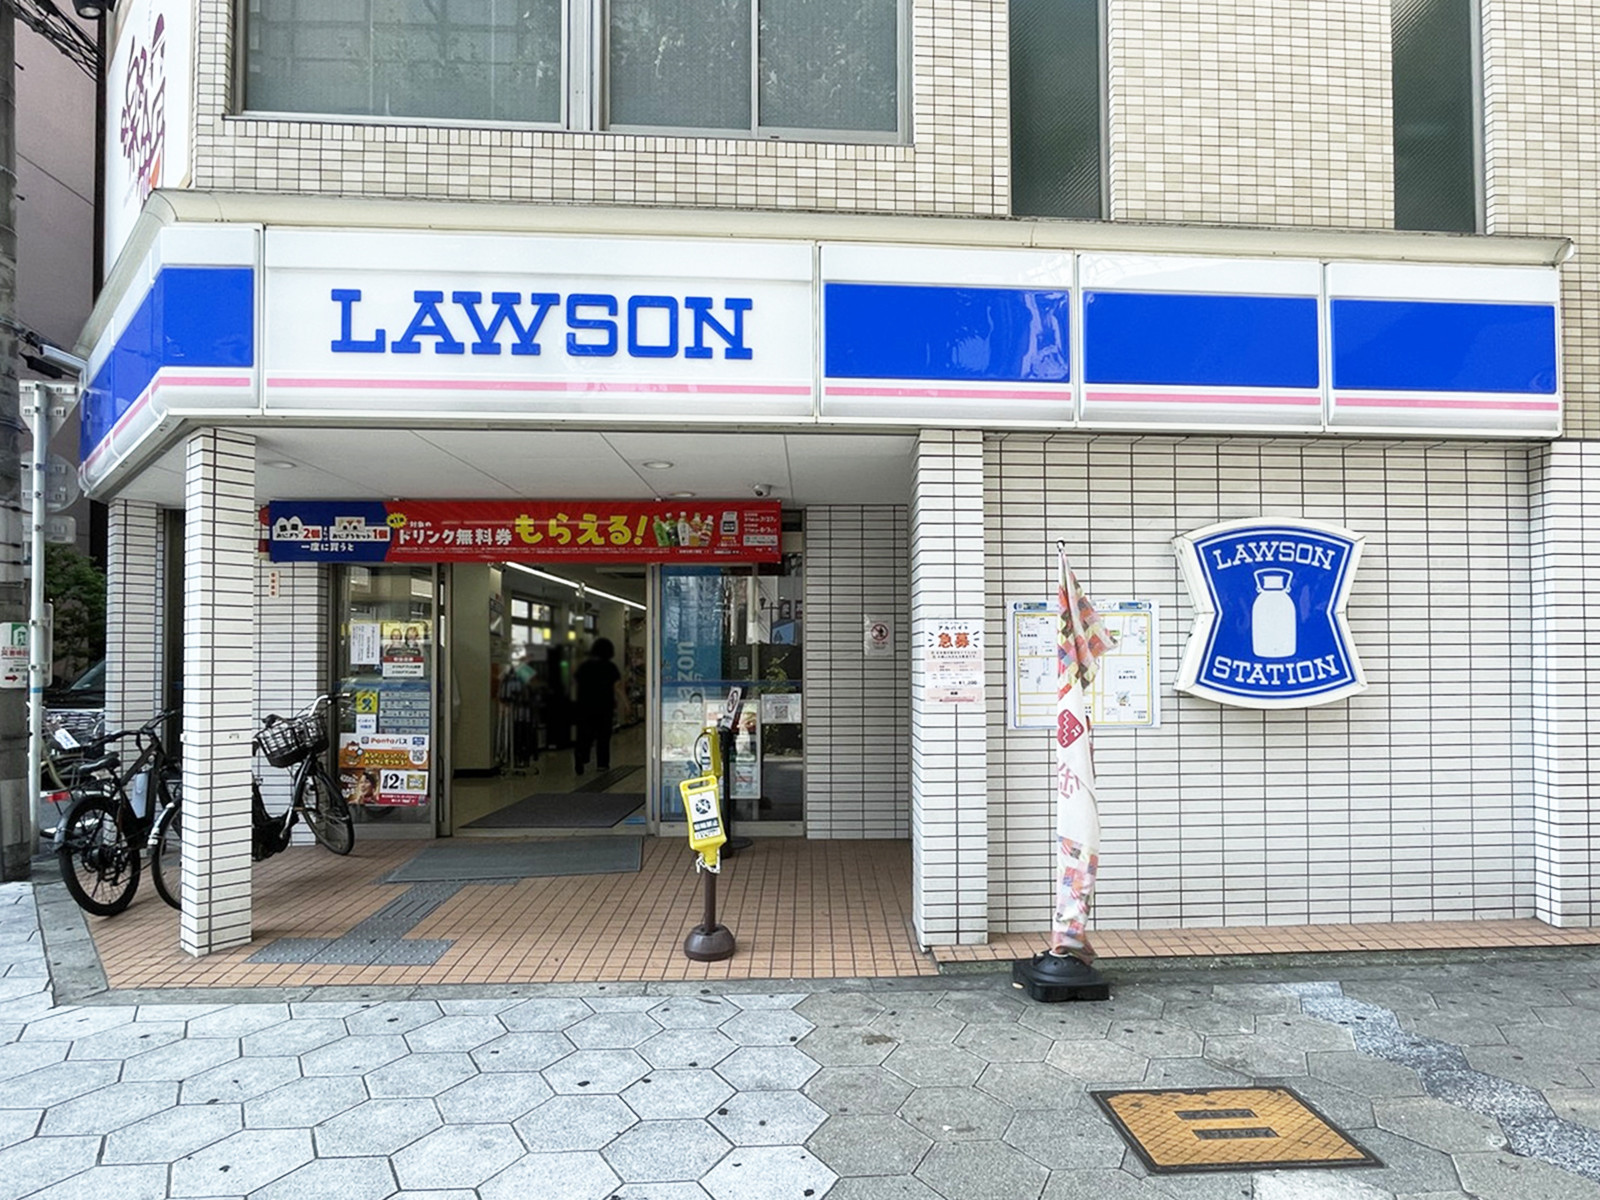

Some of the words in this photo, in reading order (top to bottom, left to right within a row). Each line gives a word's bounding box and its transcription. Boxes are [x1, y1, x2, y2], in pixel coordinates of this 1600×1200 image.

[331, 288, 753, 360] LAWSON
[399, 528, 512, 545] ドリンク無料券
[301, 542, 354, 552] 一度に買うと
[1213, 541, 1335, 571] LAWSON
[937, 632, 970, 648] 急募
[1212, 654, 1340, 685] STATION
[1070, 724, 1081, 738] 2F
